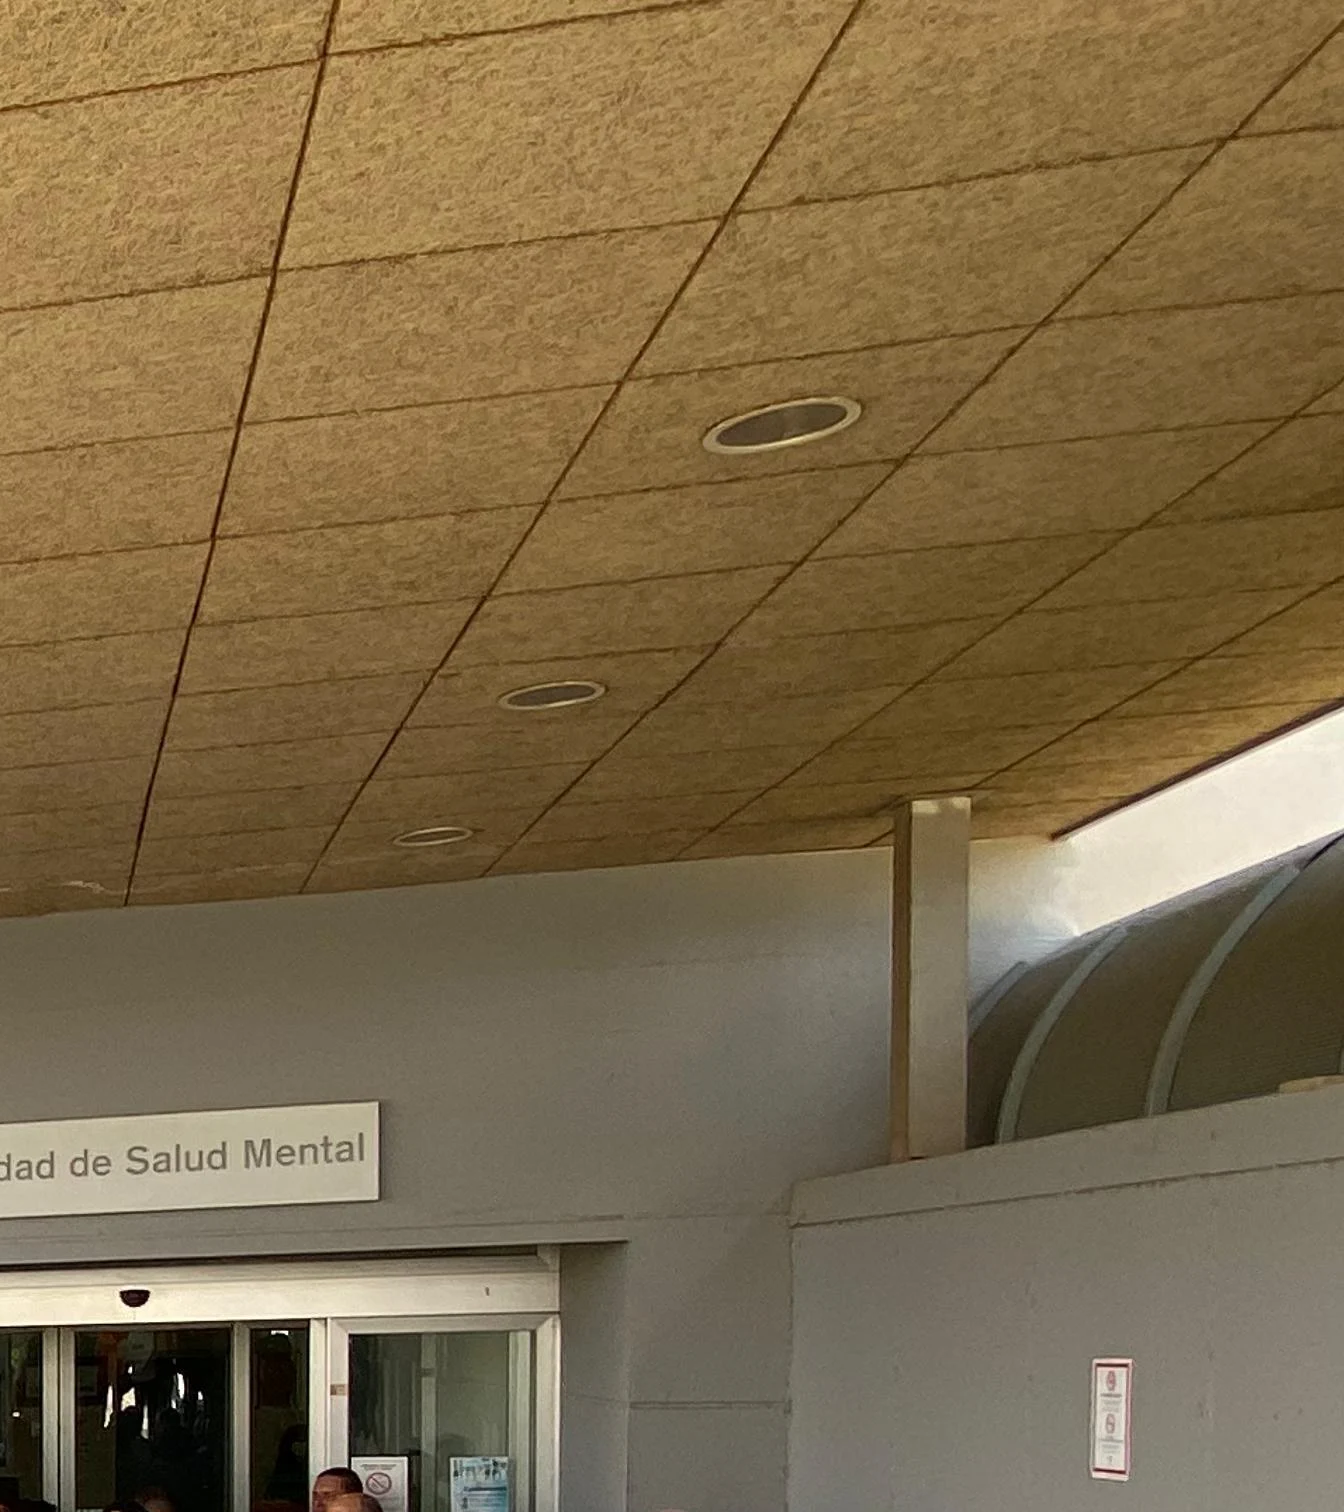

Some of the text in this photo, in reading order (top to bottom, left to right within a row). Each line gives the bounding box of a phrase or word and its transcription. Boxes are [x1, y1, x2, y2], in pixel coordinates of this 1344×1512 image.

[69, 1147, 112, 1177] de
[125, 1141, 228, 1176] Salud
[243, 1132, 366, 1169] Mental
